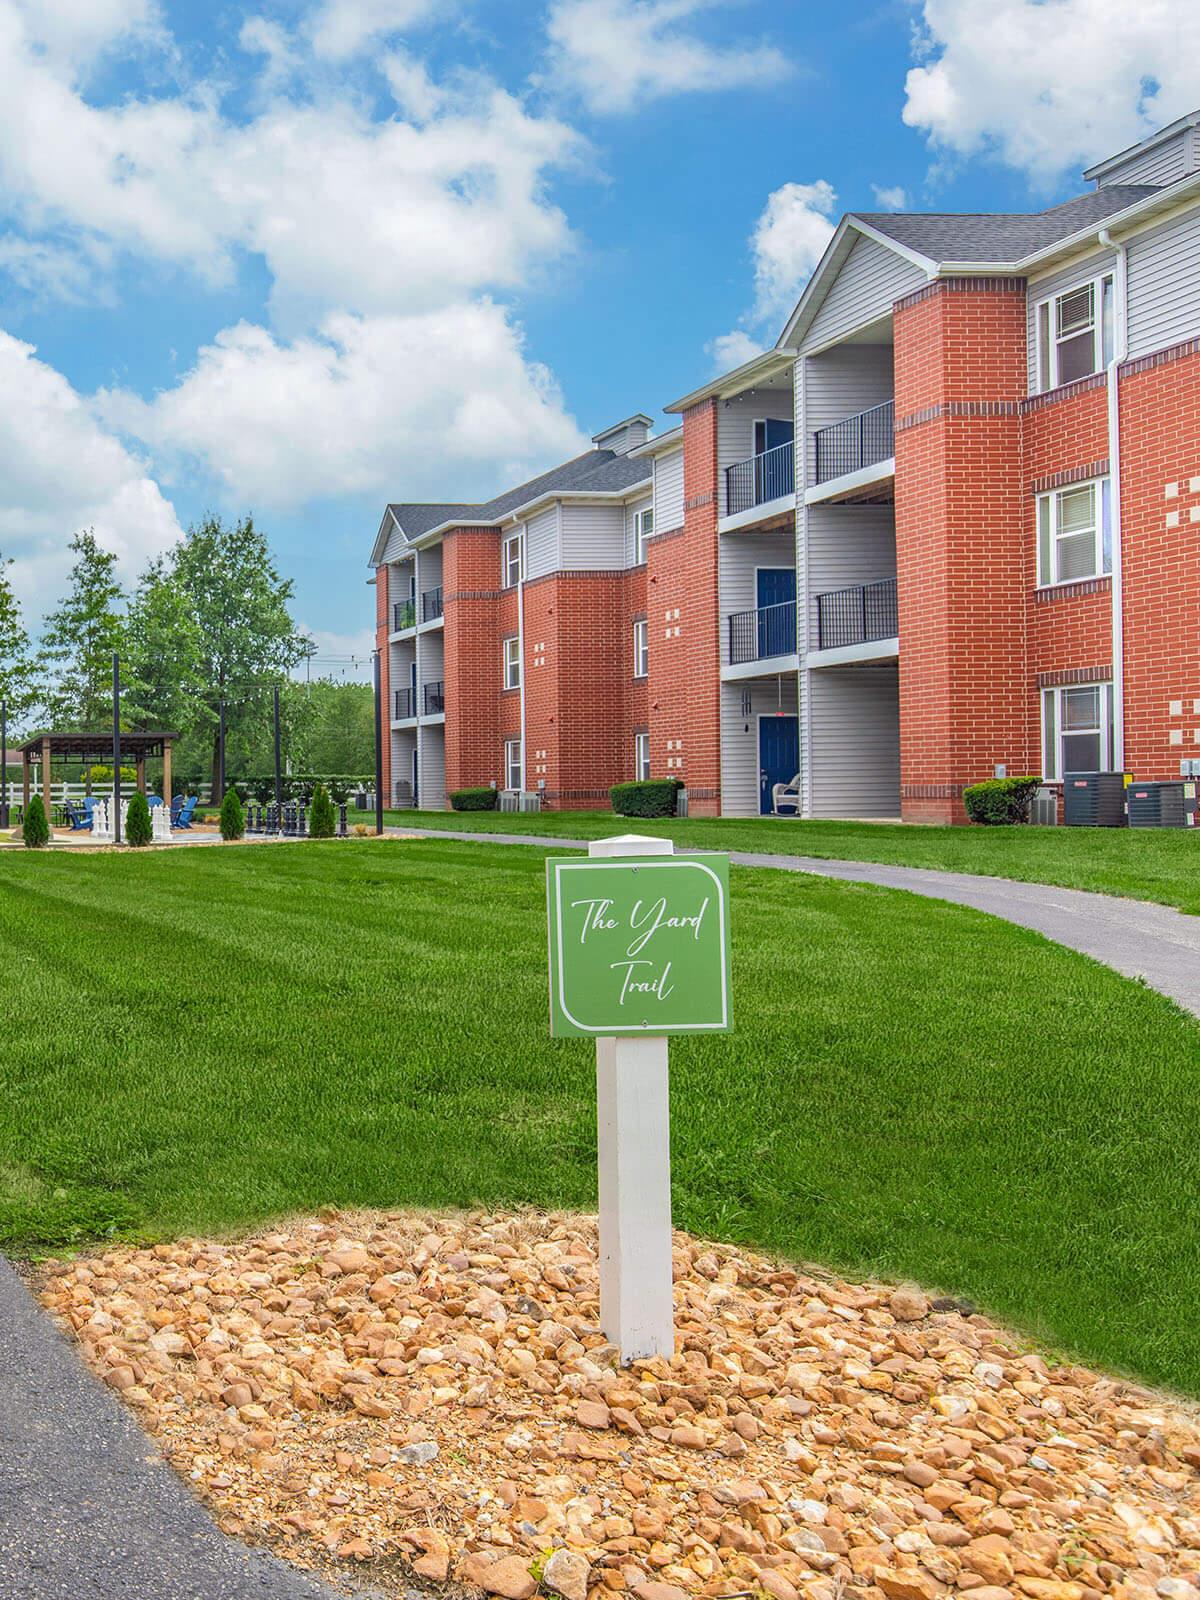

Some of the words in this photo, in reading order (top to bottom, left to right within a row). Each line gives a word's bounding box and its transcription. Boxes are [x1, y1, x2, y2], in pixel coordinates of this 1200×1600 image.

[571, 899, 619, 944] The
[627, 897, 709, 957] Yard
[610, 960, 674, 1005] Trail
